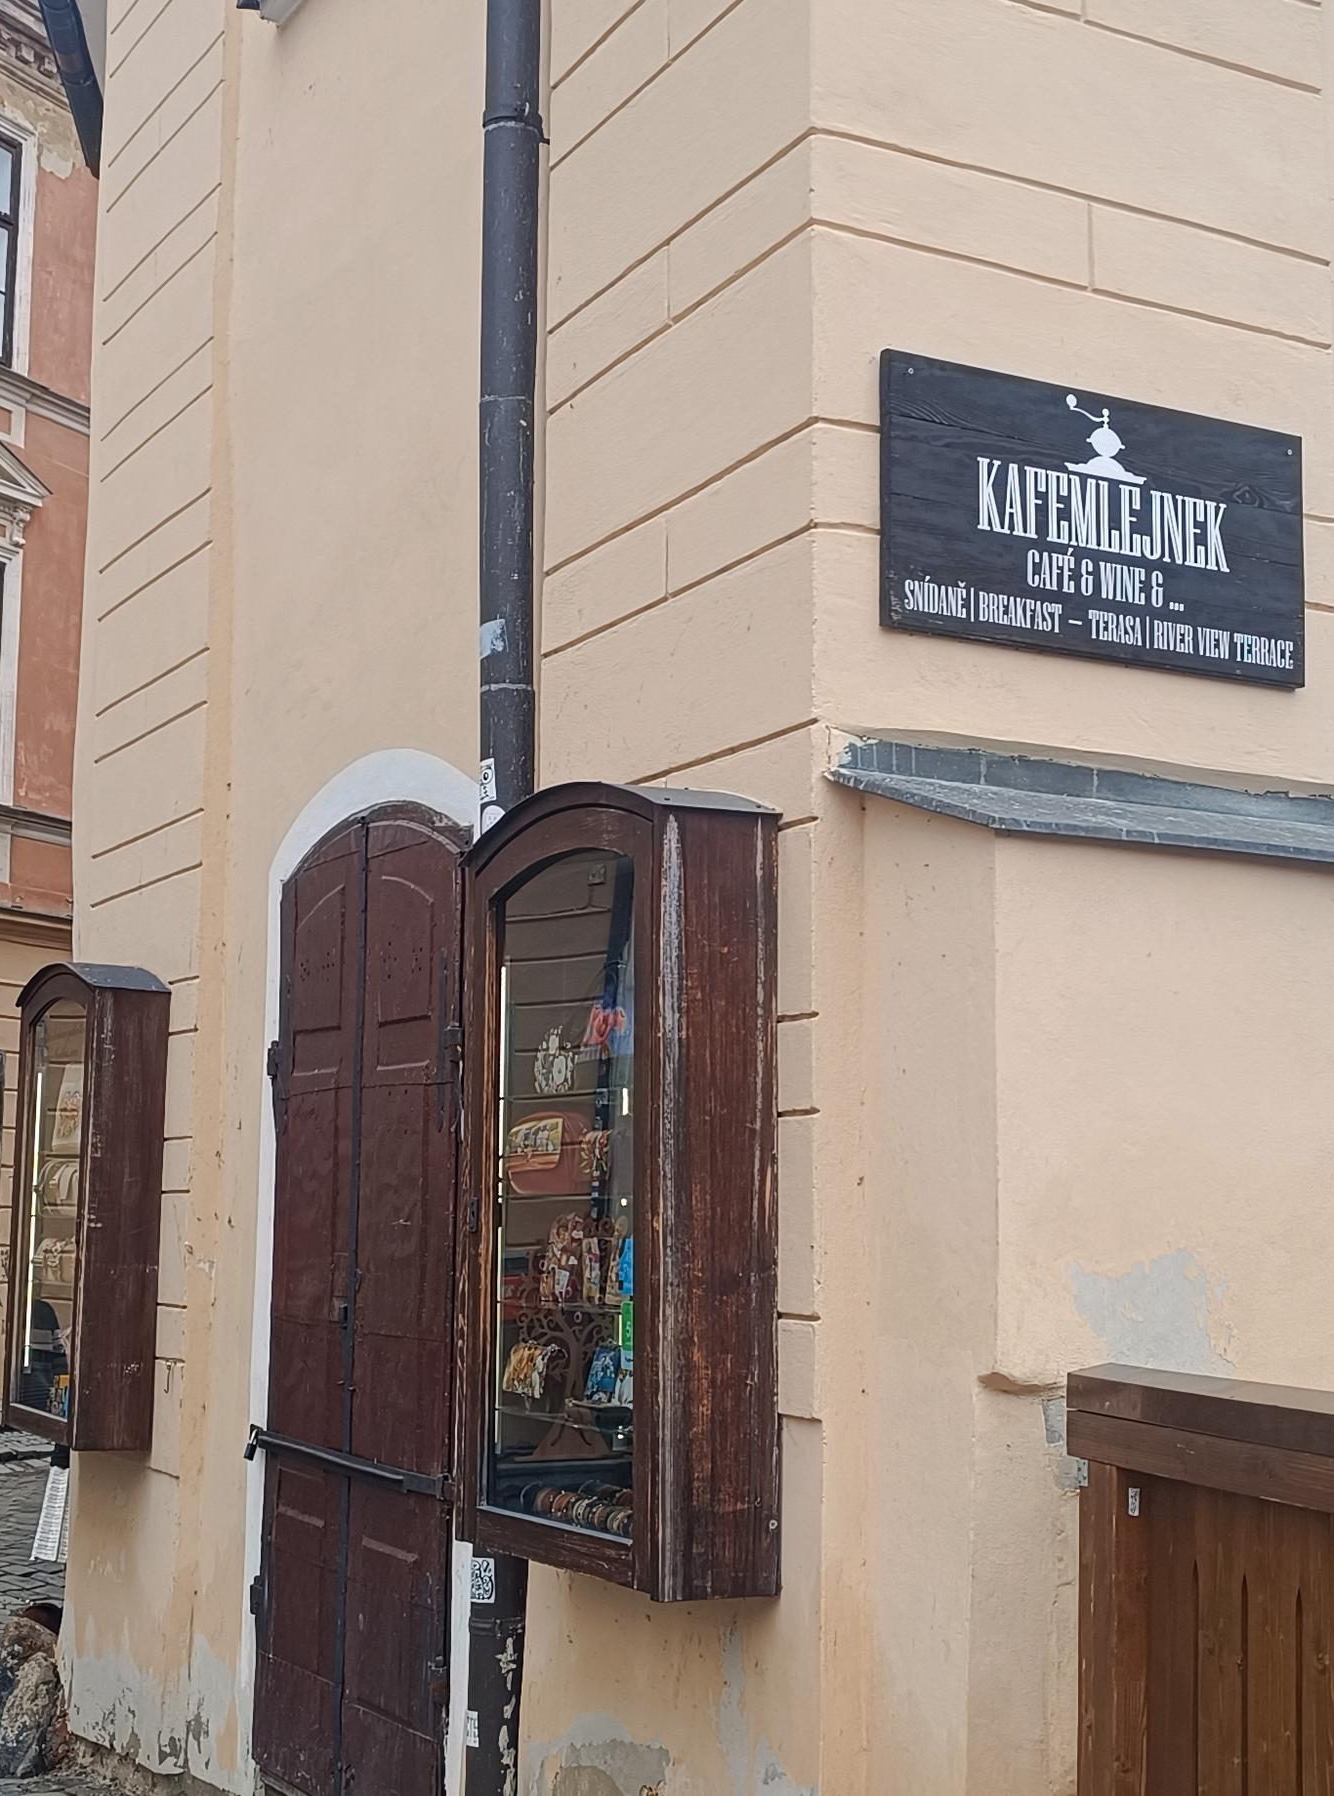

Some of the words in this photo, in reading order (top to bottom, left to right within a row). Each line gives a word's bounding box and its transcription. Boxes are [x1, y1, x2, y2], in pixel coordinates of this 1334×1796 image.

[976, 456, 1230, 573] KAFEMLEJNEK
[904, 575, 966, 619] SNÍDANĚ
[978, 591, 1063, 634] BREAKFAST
[1088, 609, 1143, 647] TERASA
[1153, 623, 1194, 655] RIVER
[1196, 628, 1231, 660] VIEW
[1233, 633, 1294, 670] TERRACE
[1027, 548, 1075, 594] CAFÉ
[1080, 558, 1094, 597] &
[1098, 561, 1146, 606] WINE
[1151, 570, 1164, 608] &
